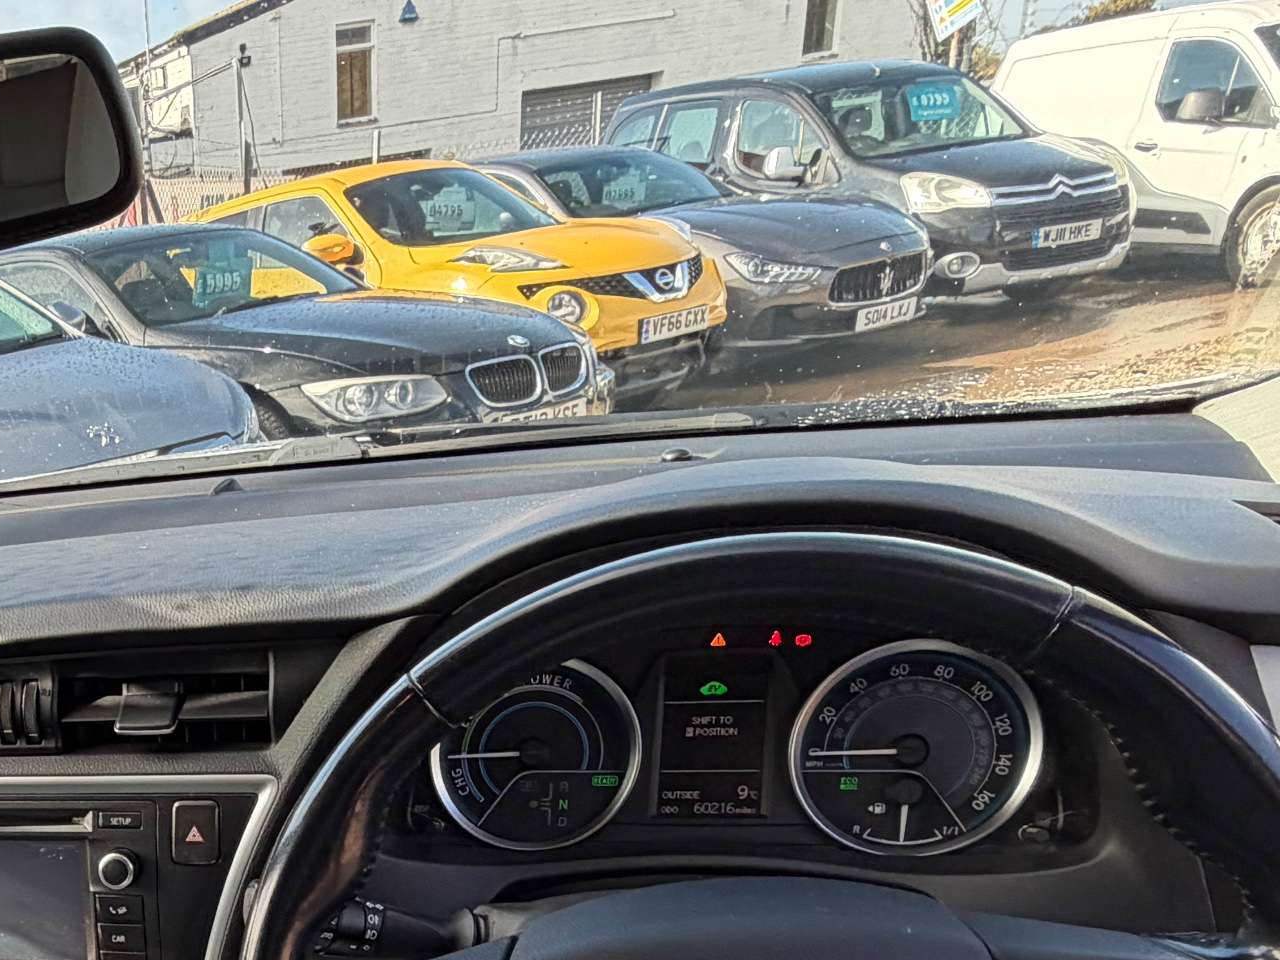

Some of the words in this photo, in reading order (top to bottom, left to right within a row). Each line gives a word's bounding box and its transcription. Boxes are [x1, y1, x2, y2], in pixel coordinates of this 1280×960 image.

[1068, 223, 1092, 239] HKE
[889, 304, 911, 321] LXJ
[652, 312, 682, 336] VF66
[684, 307, 708, 329] GXX
[889, 663, 909, 677] 60
[933, 664, 955, 679] 80
[848, 678, 868, 694] 40
[970, 680, 993, 702] 100
[691, 715, 716, 725] SHIFT
[719, 715, 733, 725] TO
[819, 706, 837, 724] 20
[695, 727, 738, 736] POSITION
[995, 713, 1013, 737] 120
[996, 753, 1014, 776] 140
[451, 767, 470, 797] CHG
[840, 776, 858, 784] ECO
[662, 790, 701, 800] OUTSIDE
[971, 789, 995, 811] 160
[559, 799, 568, 809] N
[693, 802, 735, 814] 60216
[110, 817, 132, 826] SETUP
[853, 825, 860, 835] R
[942, 825, 959, 836] 1/1
[111, 934, 126, 943] CAR
